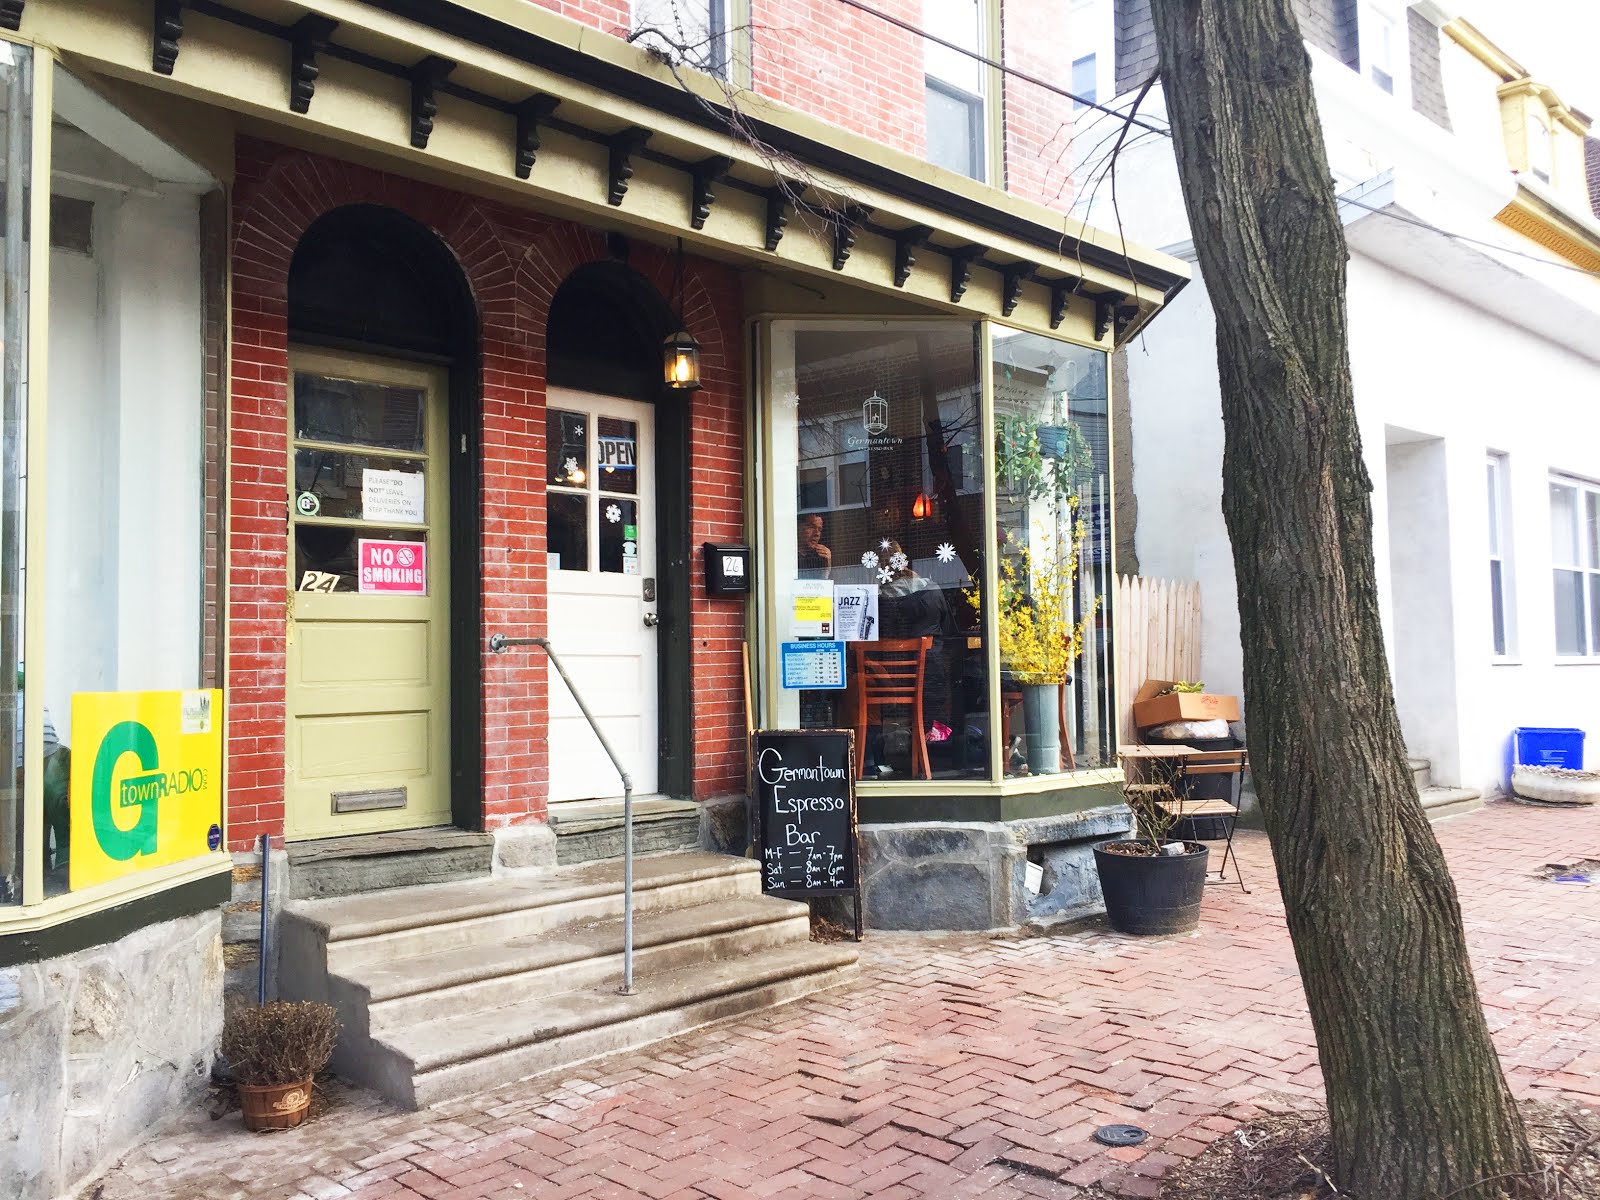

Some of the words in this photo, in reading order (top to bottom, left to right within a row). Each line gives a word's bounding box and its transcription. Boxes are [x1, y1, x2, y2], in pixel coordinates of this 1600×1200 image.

[848, 436, 903, 447] Germantown
[598, 440, 637, 465] OPEN
[368, 477, 389, 485] PLEASE
[386, 488, 404, 496] LEAVE
[368, 496, 401, 505] DELIVERIES
[384, 507, 404, 515] THANK
[371, 548, 394, 566] NO
[726, 556, 740, 572] 26
[302, 573, 335, 593] 24
[363, 567, 423, 584] SMOKING
[838, 596, 861, 606] JAZZ
[92, 720, 159, 861] G
[774, 785, 844, 824] Espresso
[785, 823, 821, 846] Bar
